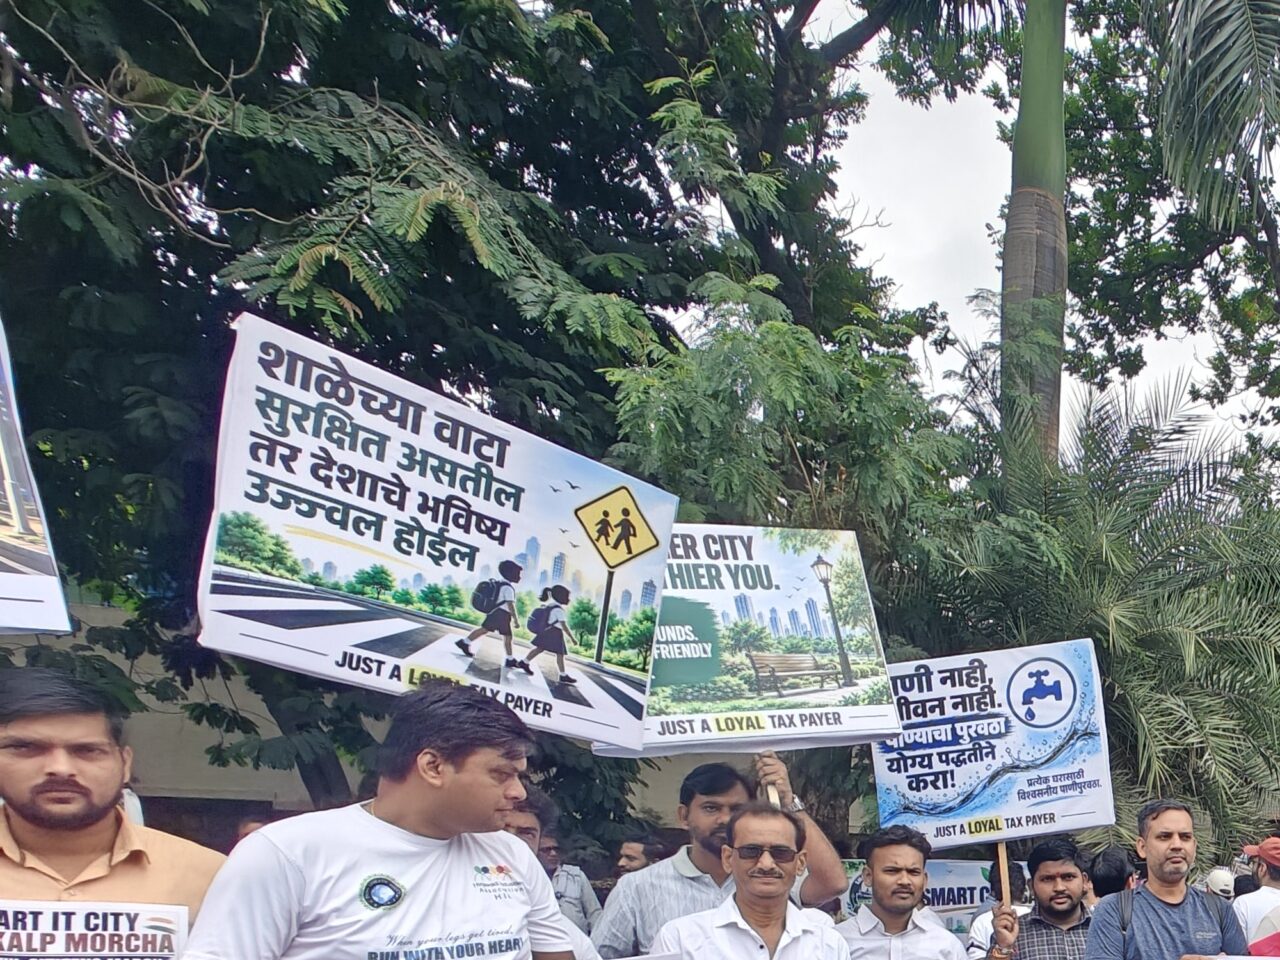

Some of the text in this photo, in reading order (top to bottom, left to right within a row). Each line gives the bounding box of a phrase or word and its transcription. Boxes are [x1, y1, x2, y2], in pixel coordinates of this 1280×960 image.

[258, 340, 511, 468] शाळेच्या वाटा
[255, 385, 525, 512] सुरक्षित असतील
[249, 431, 510, 546] तर देशाचे भविष्य
[244, 469, 480, 572] उज्ज्वल होईल
[702, 533, 753, 561] CITY
[724, 563, 781, 590] YOU.
[938, 658, 993, 689] नाही,
[950, 685, 1002, 713] नाही.
[955, 716, 1006, 744] पुरवठा
[886, 741, 996, 775] योग्य पद्धतीने
[906, 770, 956, 794] करा!
[1027, 768, 1085, 787] प्रत्येक घरासाठी
[1017, 785, 1058, 801] विश्वसनीय
[923, 886, 976, 906] SMART
[52, 911, 76, 931] IT
[84, 912, 139, 931] CITY
[64, 933, 174, 953] MORCHA
[446, 943, 486, 960] YOUR
